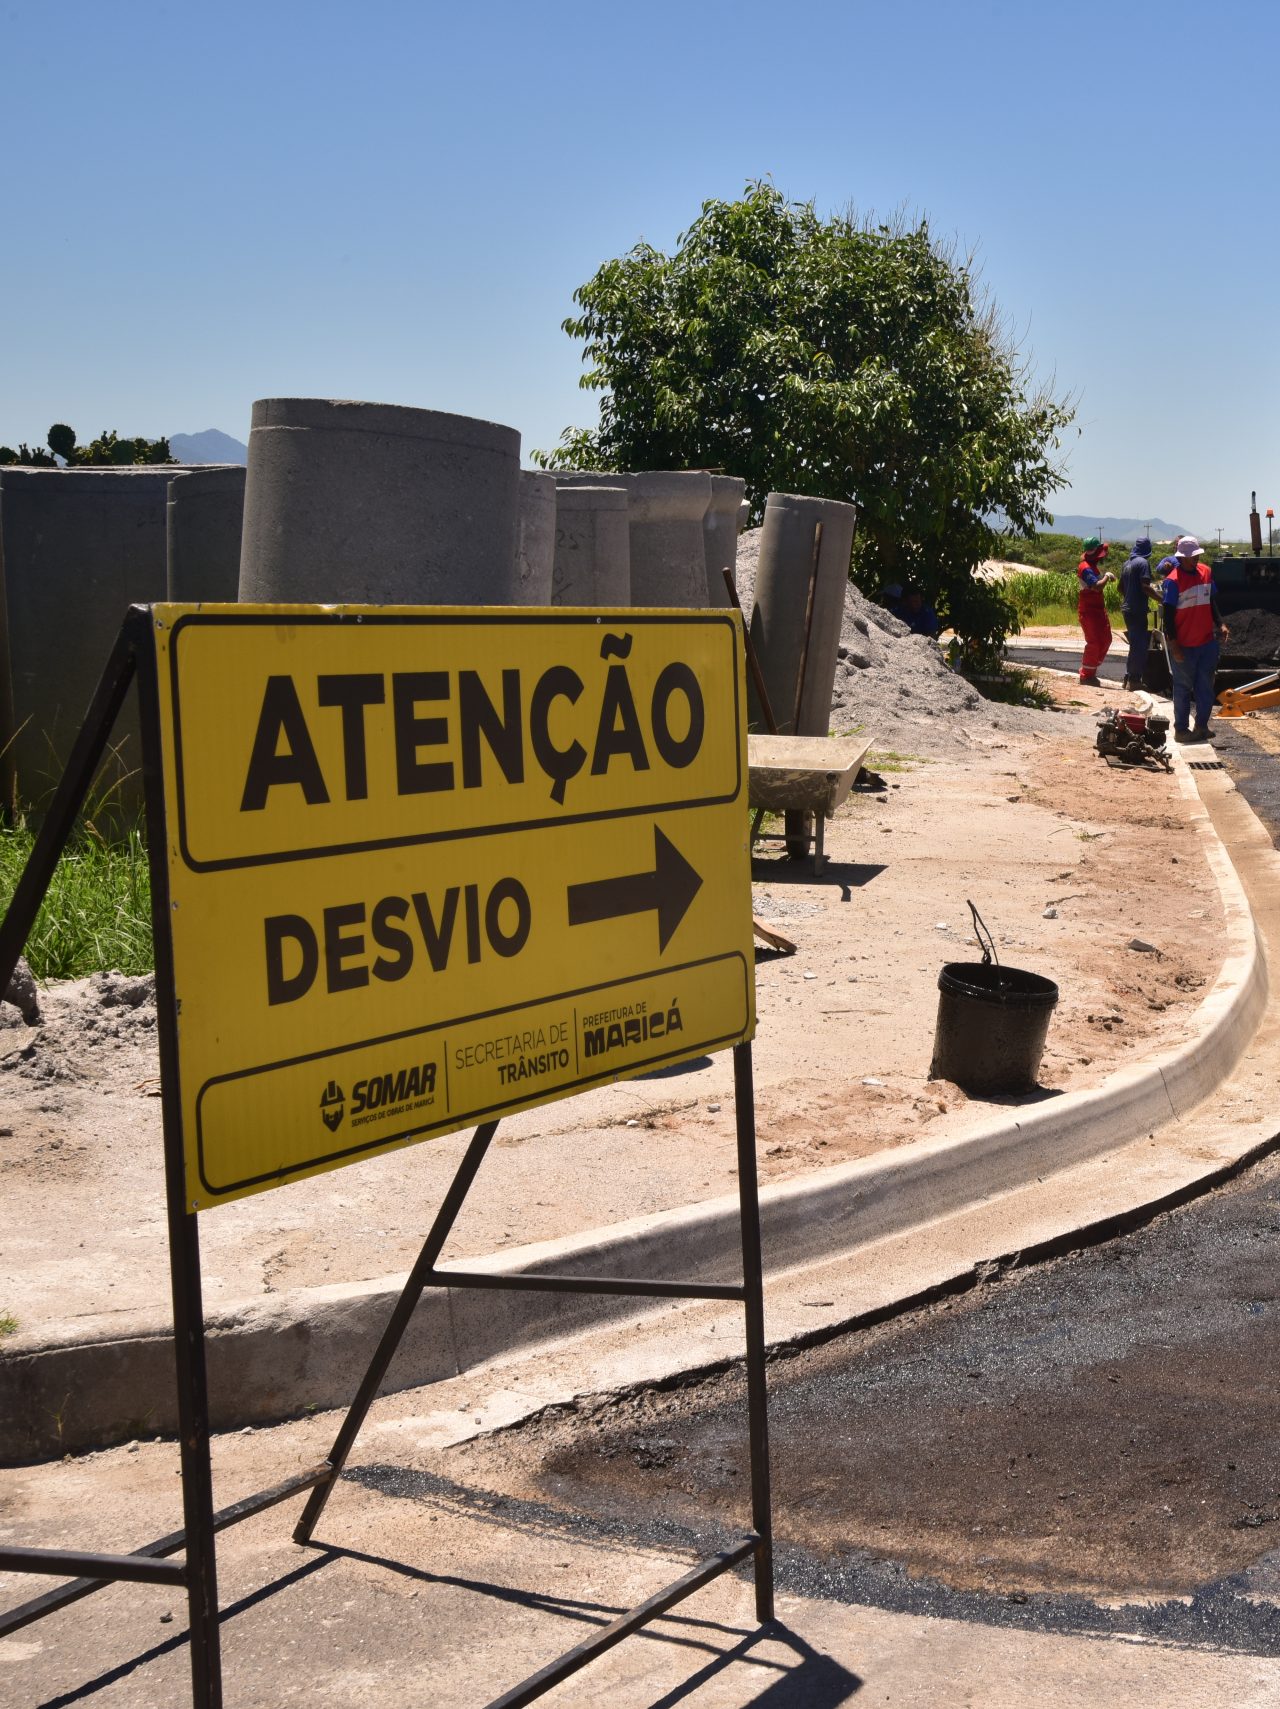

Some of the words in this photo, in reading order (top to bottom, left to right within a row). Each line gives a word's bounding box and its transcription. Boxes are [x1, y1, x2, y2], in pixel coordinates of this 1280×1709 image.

[239, 632, 705, 812] ATENÇÃO
[264, 877, 532, 1006] DESVIO
[583, 1006, 634, 1029] PREFEITURA
[635, 1001, 647, 1014] DE
[583, 997, 683, 1058] MARICÁ
[455, 1029, 547, 1070] SECRETARIA
[550, 1021, 568, 1044] DE
[498, 1048, 570, 1086] TRÂNSITO
[350, 1062, 437, 1115] SOMAR
[352, 1112, 377, 1128] SERVIÇOS
[378, 1110, 387, 1119] DE
[387, 1106, 404, 1117] OBRAS
[405, 1103, 414, 1111] DE
[413, 1096, 435, 1110] MARICÁ
